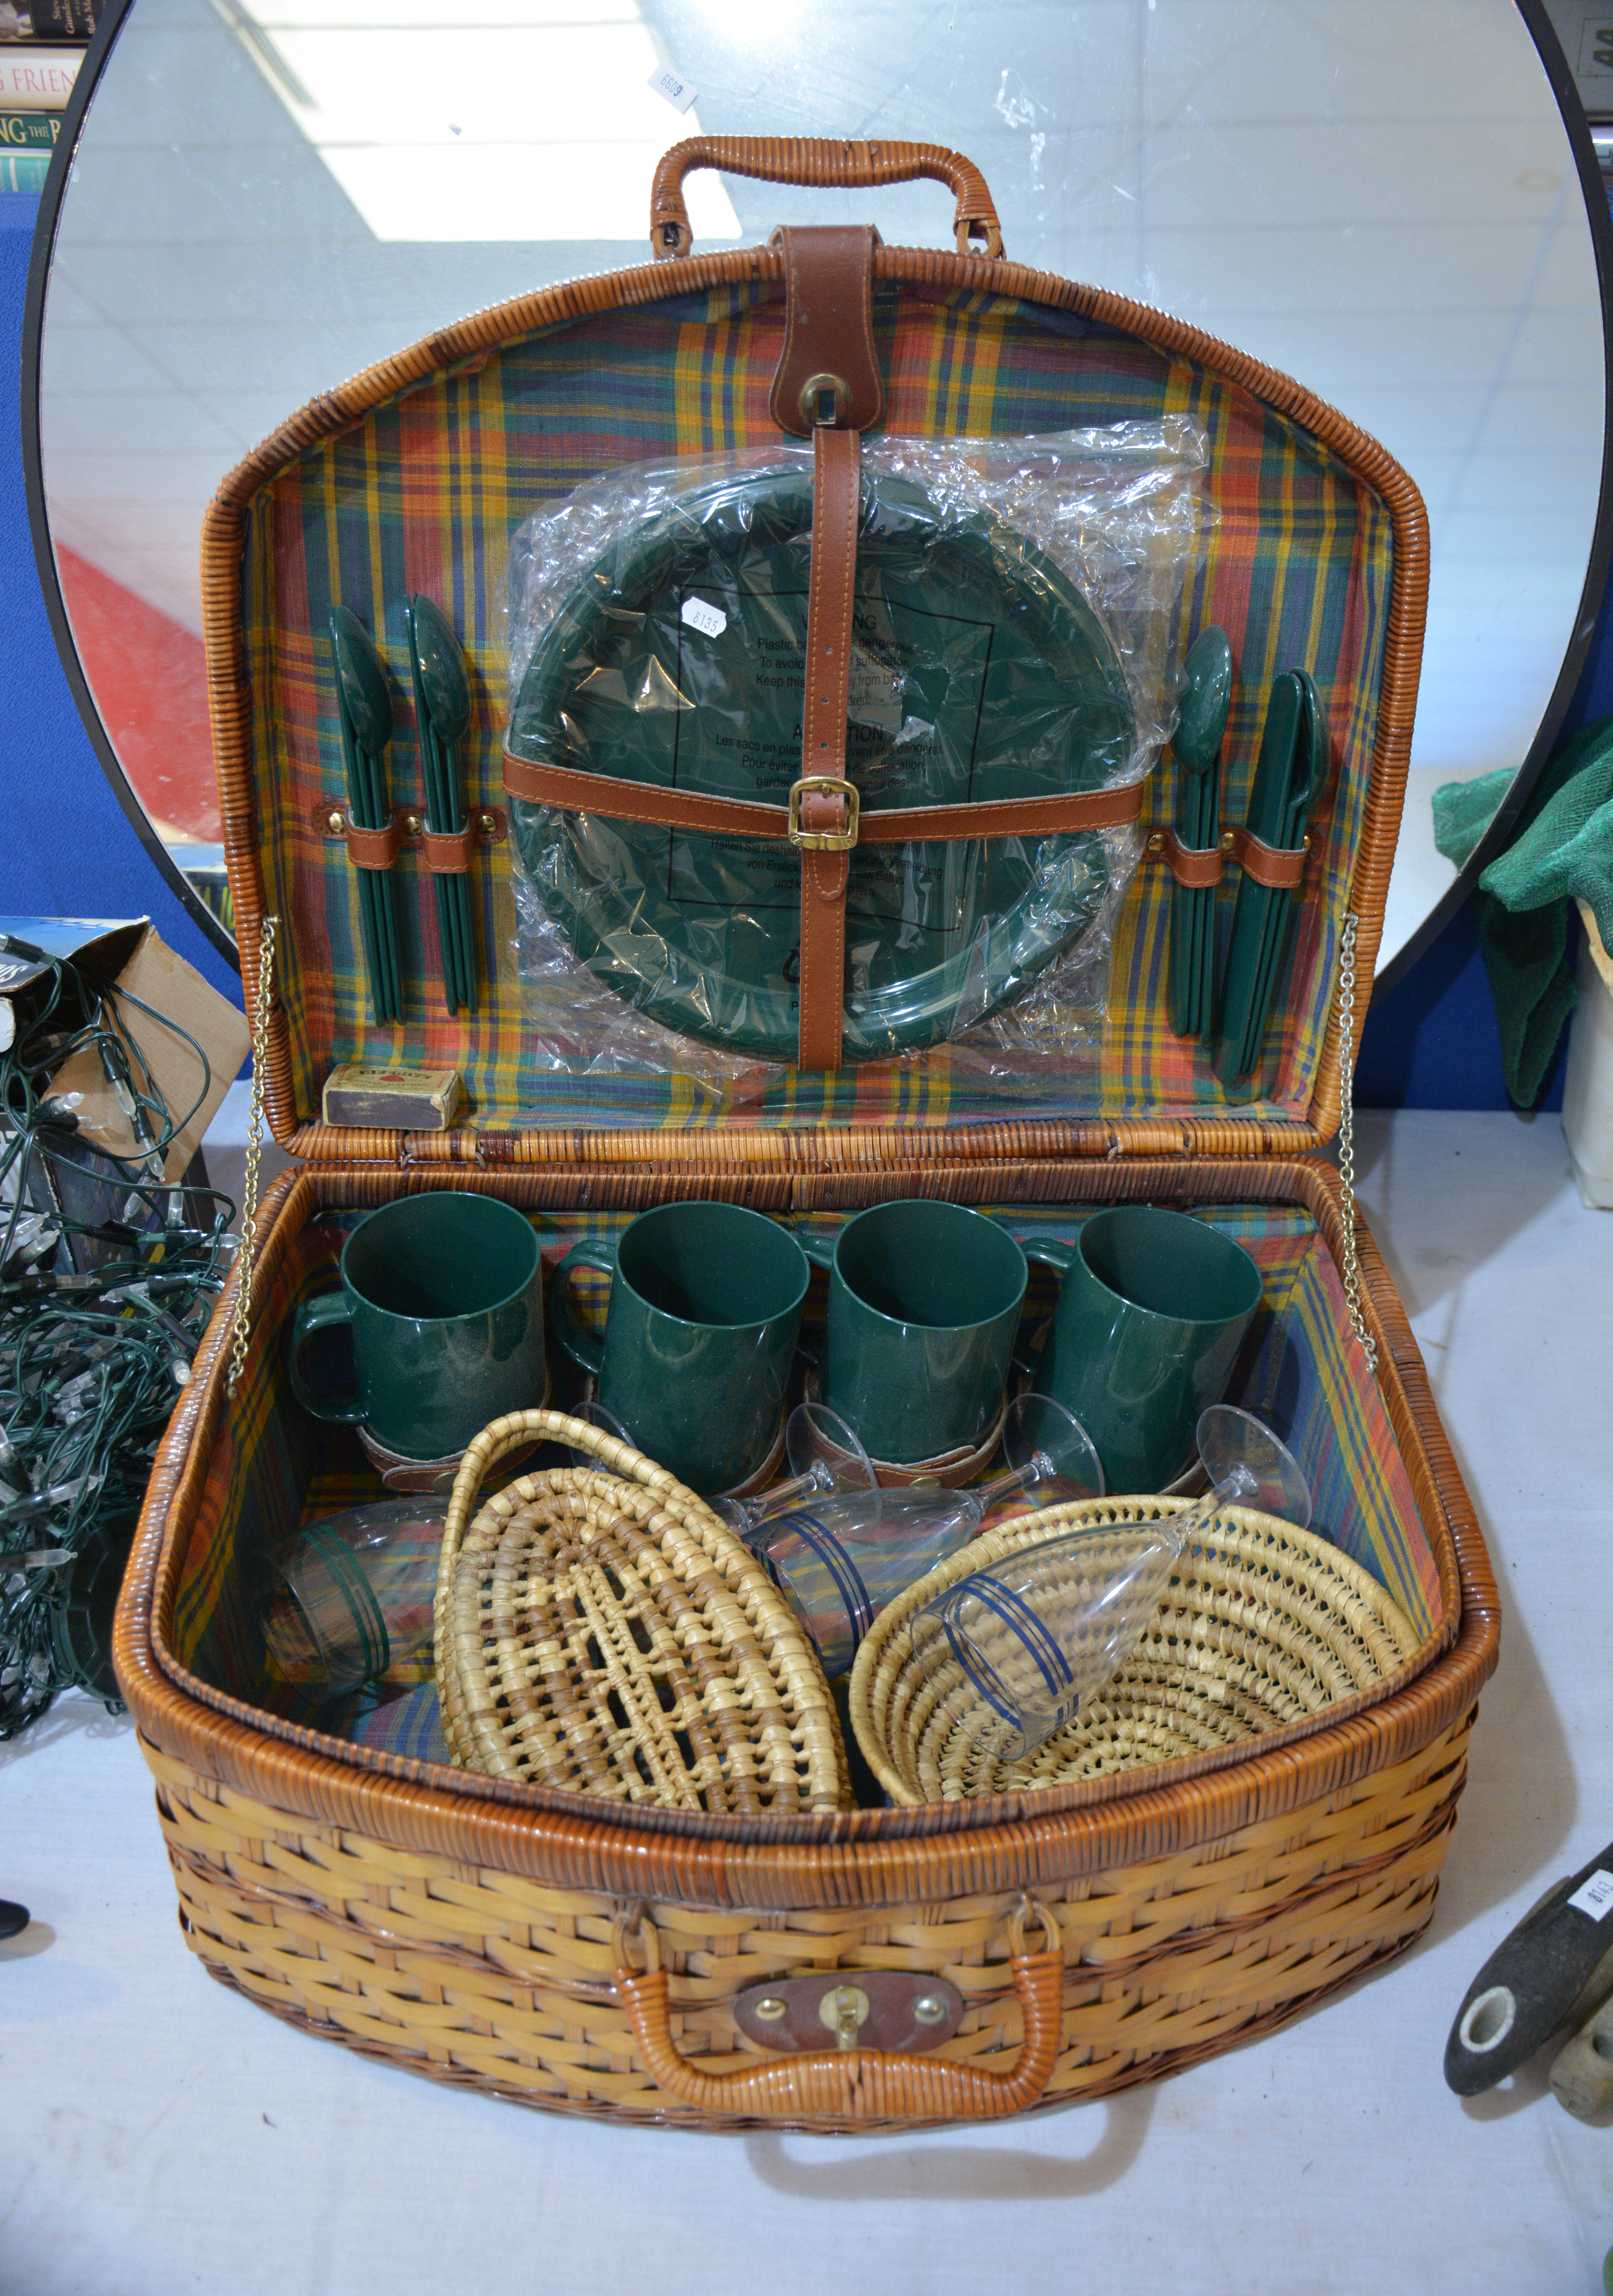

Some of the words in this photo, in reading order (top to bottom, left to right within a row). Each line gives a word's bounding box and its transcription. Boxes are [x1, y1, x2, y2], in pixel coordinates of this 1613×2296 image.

[693, 612, 718, 632] 8135
[758, 638, 793, 650] Plastic
[858, 636, 916, 657] dangerous.
[760, 656, 772, 668] To
[775, 657, 804, 670] avoid
[757, 674, 784, 689] Keep
[787, 676, 806, 688] this
[858, 674, 880, 686] from
[716, 733, 734, 747] Les
[737, 739, 761, 751] sacs
[763, 744, 776, 752] en
[875, 744, 895, 756] être
[742, 755, 766, 768] Pour
[769, 758, 798, 772] éviter
[852, 762, 865, 774] de
[756, 777, 791, 789] garder
[888, 777, 906, 788] des
[745, 841, 760, 853] Sie
[763, 843, 801, 857] deshalb
[747, 860, 764, 870] von
[775, 878, 793, 888] und
[876, 870, 905, 887] Babys
[1588, 1880, 1613, 1902] 8143
